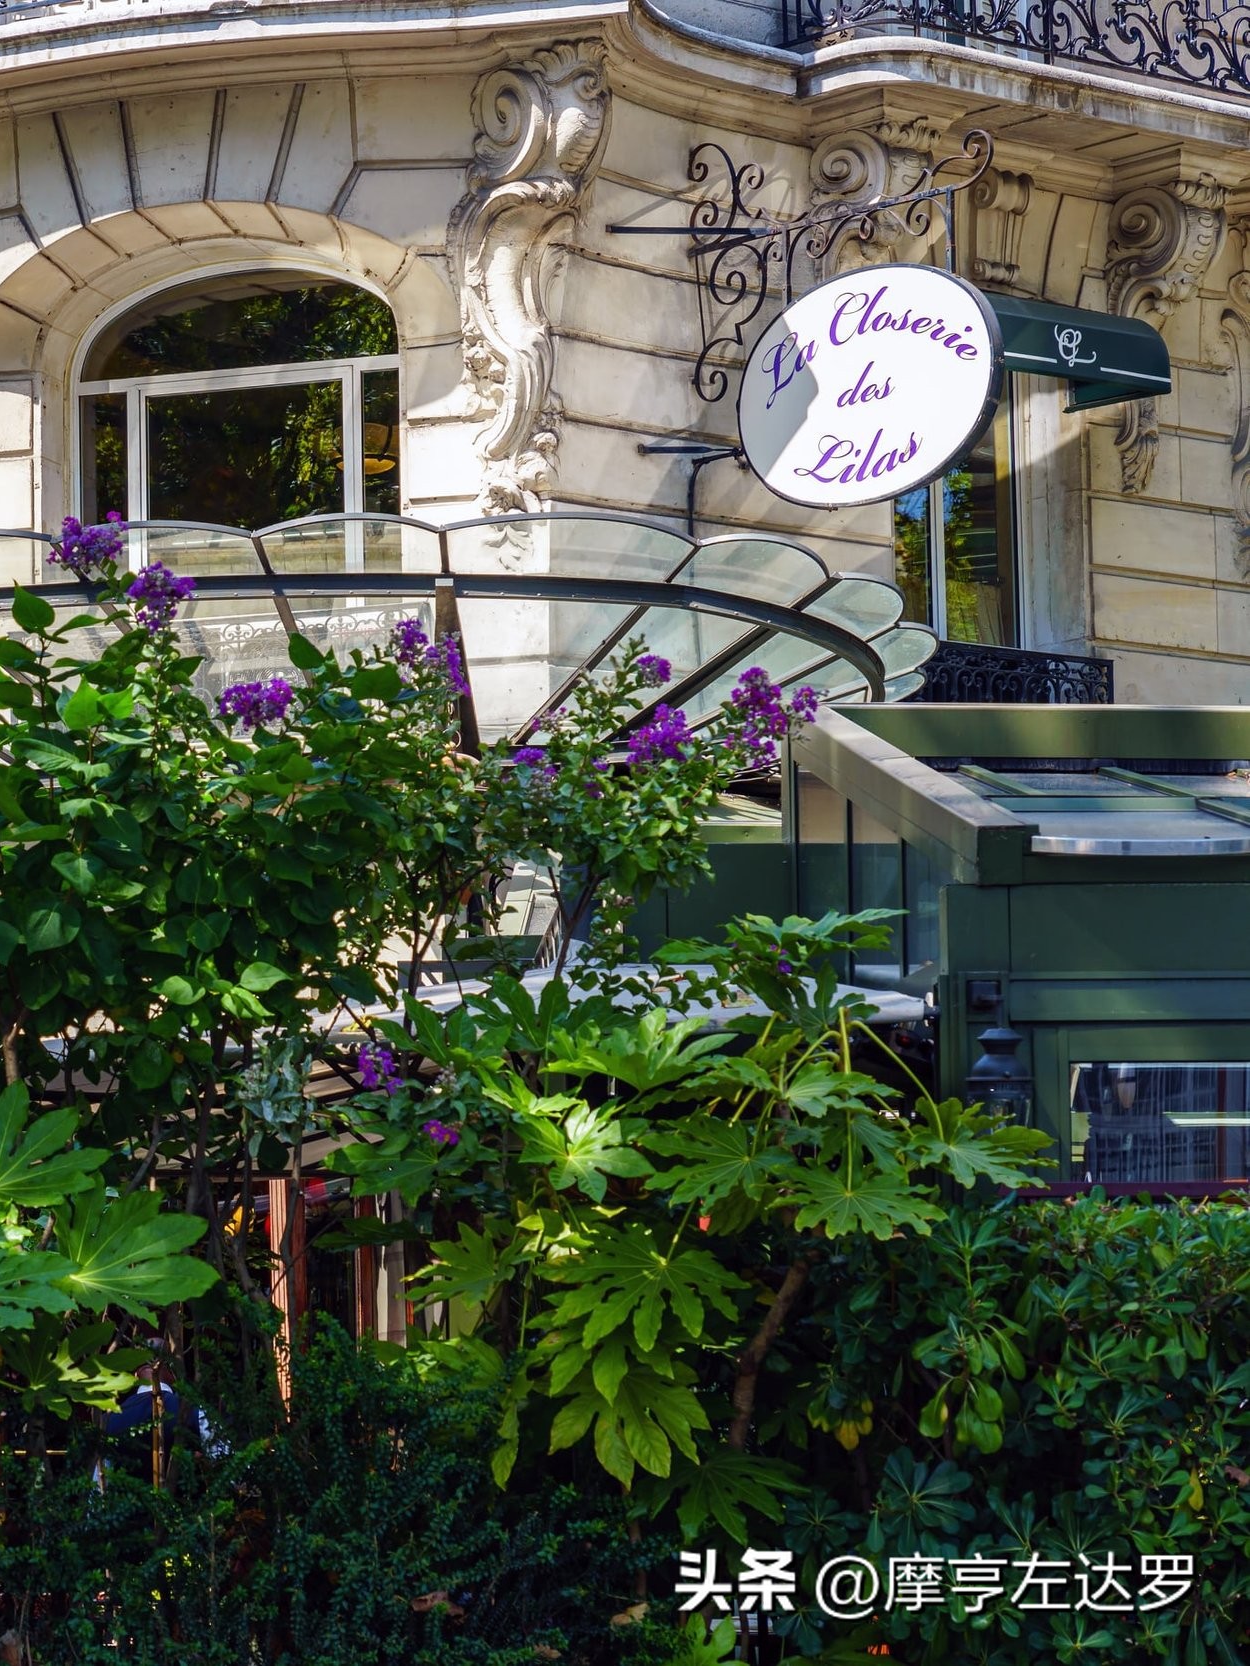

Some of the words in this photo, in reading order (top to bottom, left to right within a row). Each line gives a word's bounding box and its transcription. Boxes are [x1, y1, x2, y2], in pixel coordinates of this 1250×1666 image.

[761, 331, 819, 410] La
[830, 286, 978, 361] Closerie
[837, 361, 895, 408] des
[794, 428, 923, 484] Lilas
